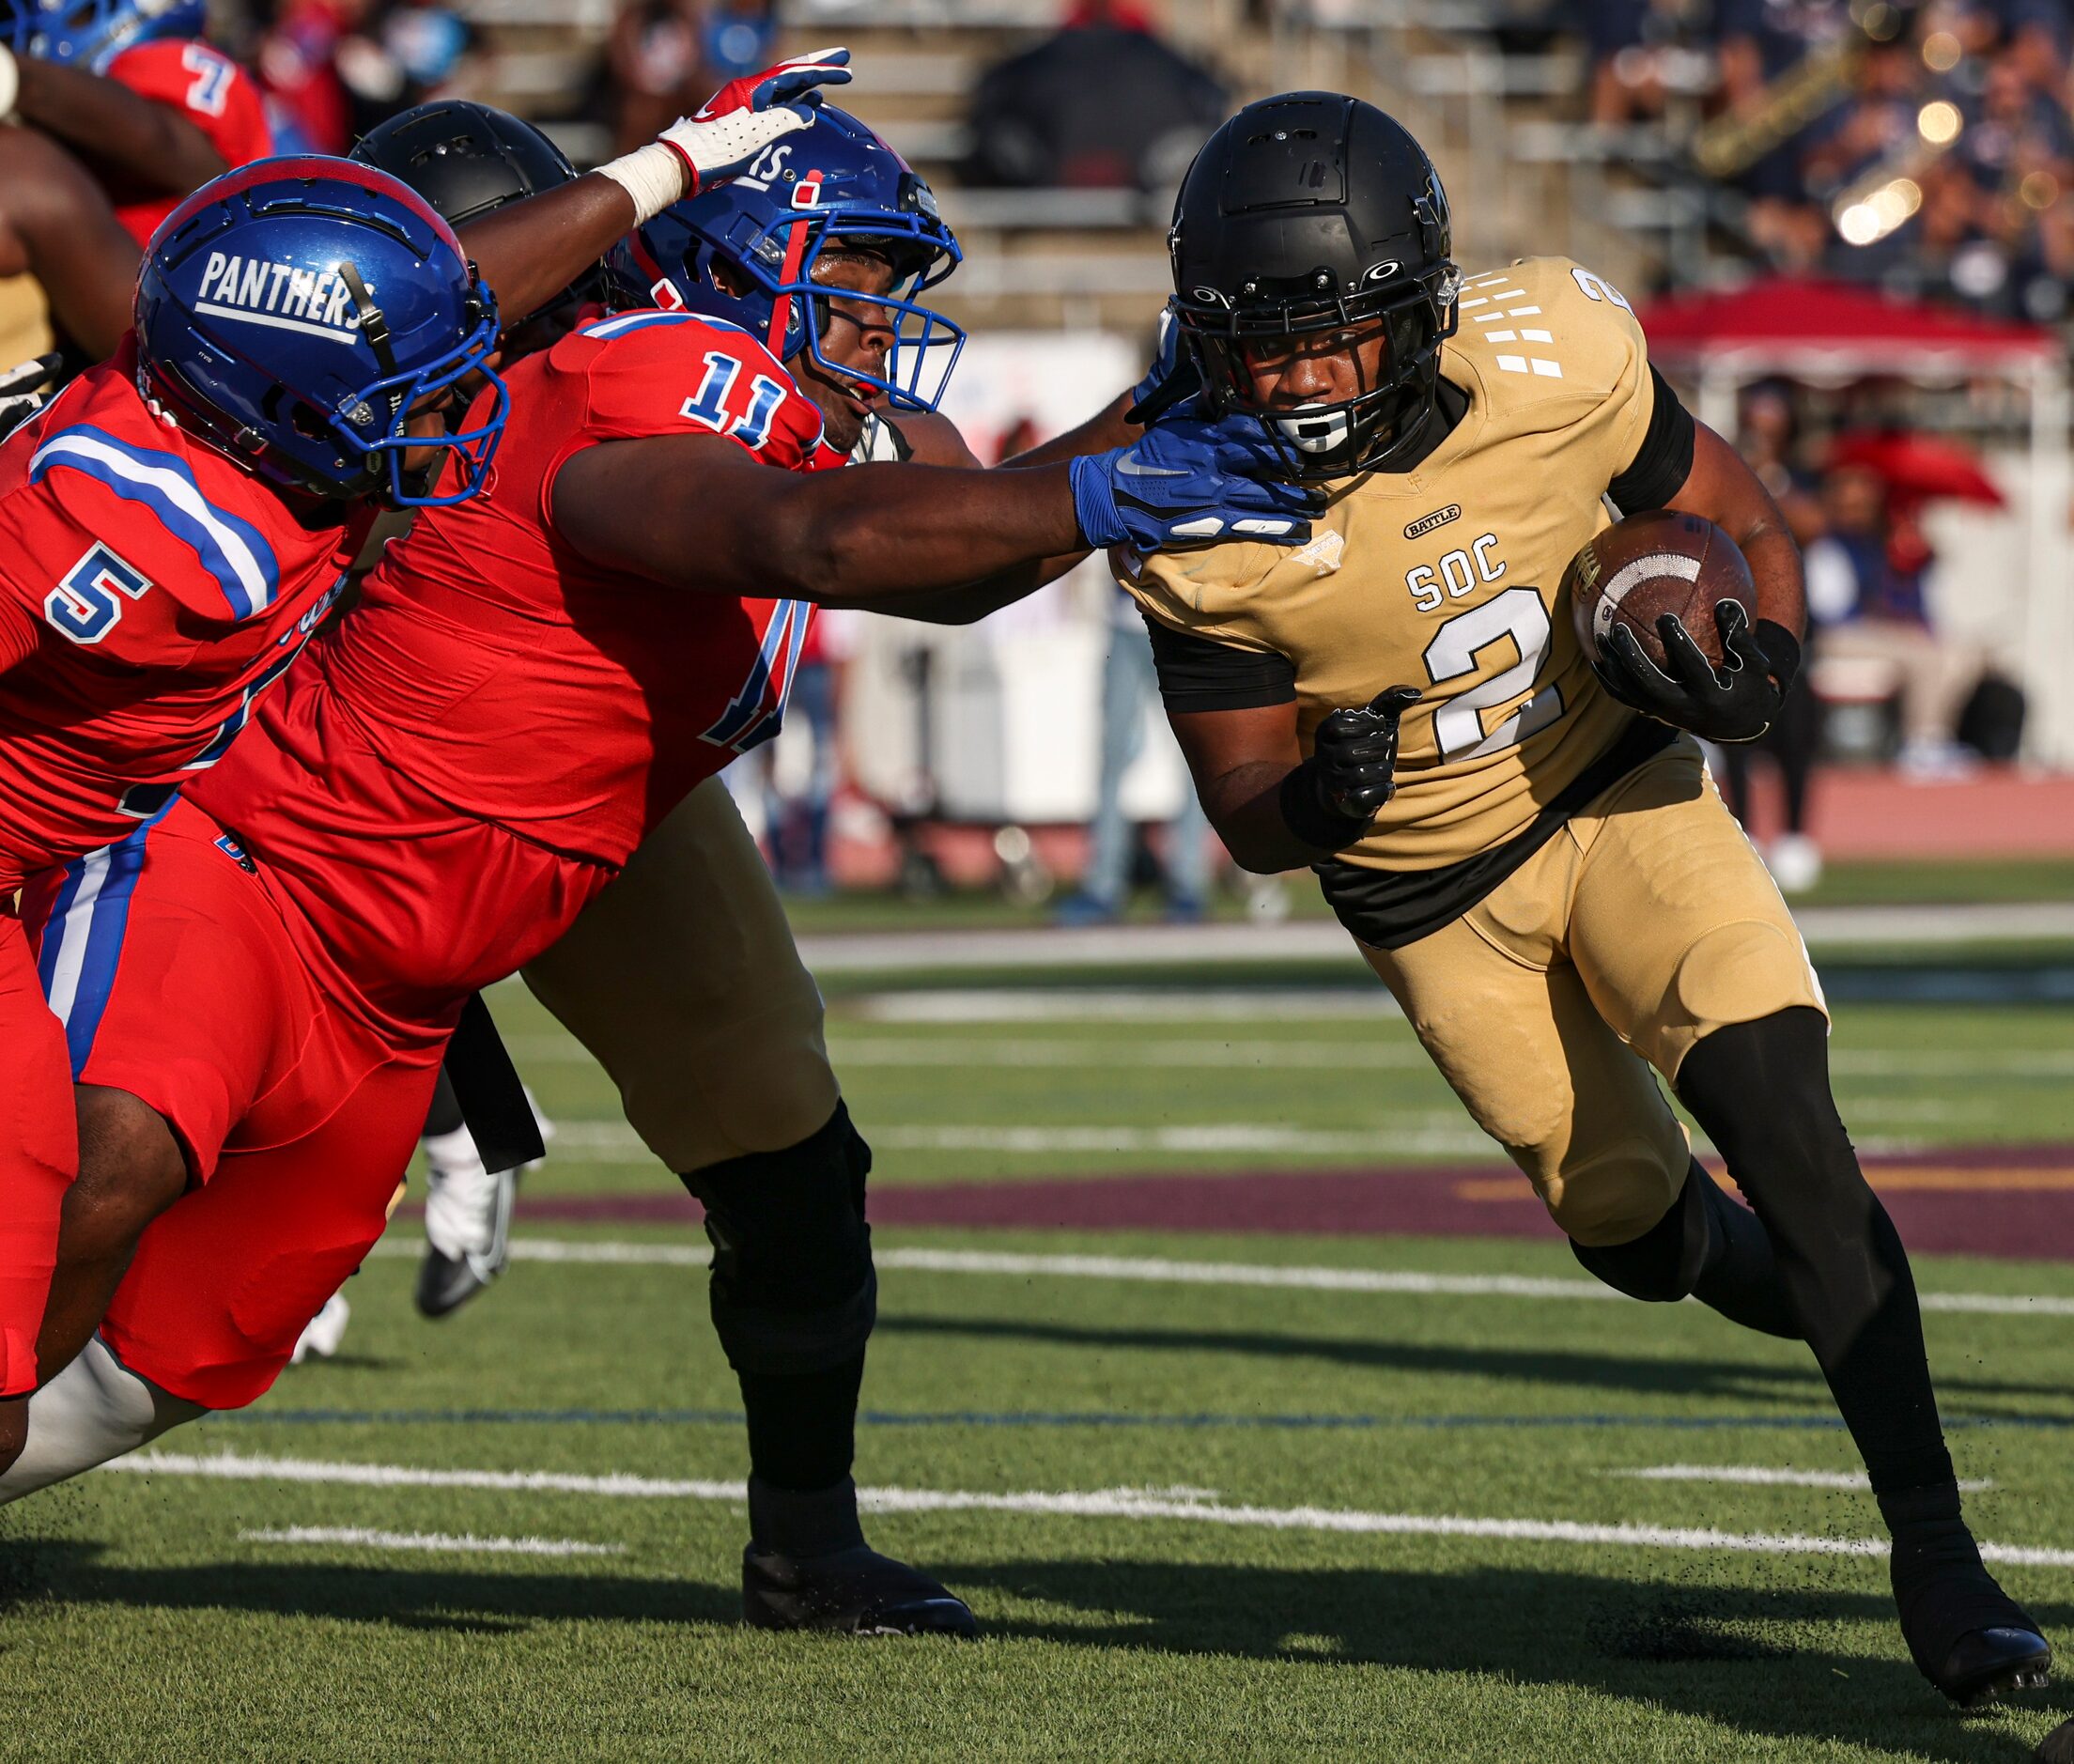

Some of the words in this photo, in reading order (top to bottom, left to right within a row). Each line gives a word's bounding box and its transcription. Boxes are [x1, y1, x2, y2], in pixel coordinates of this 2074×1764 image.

[182, 43, 236, 118] 7
[678, 350, 788, 451] 11
[1407, 506, 1459, 536] BATTLE
[43, 539, 155, 644] 5
[1404, 532, 1508, 612] SOC
[1421, 585, 1567, 766] 2
